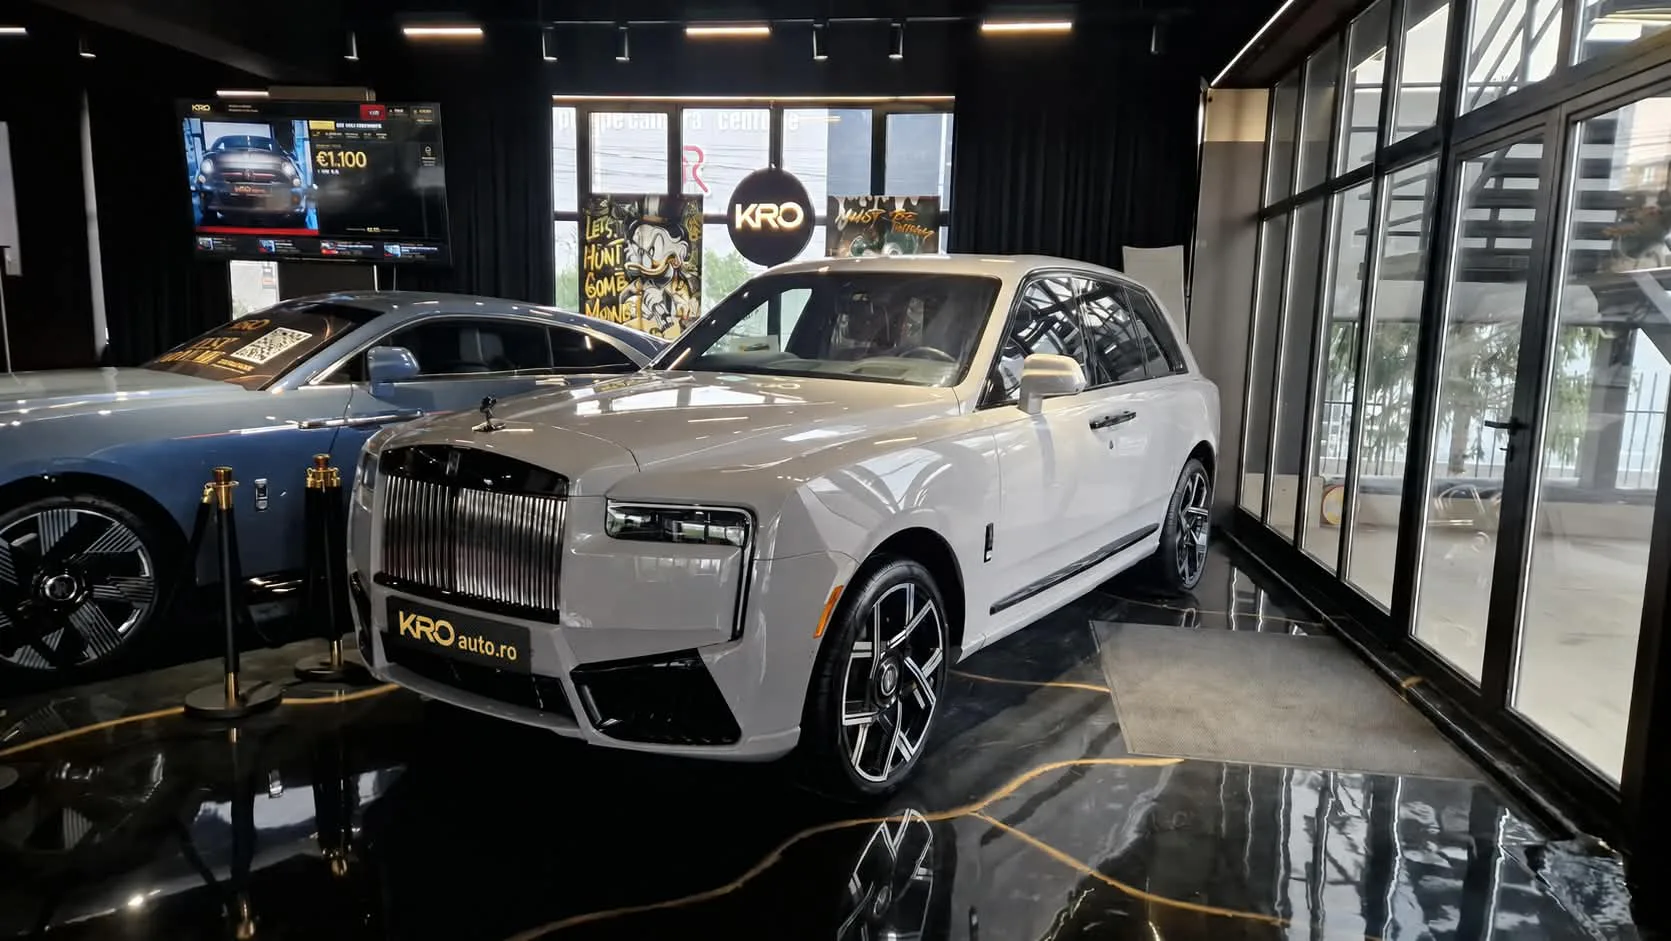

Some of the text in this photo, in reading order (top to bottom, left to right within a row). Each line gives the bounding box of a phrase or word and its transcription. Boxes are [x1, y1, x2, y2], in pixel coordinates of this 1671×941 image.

[316, 150, 368, 168] €1.100
[735, 201, 805, 230] KRO
[584, 239, 625, 271] HUNT
[399, 611, 517, 661] KRO auto.ro
